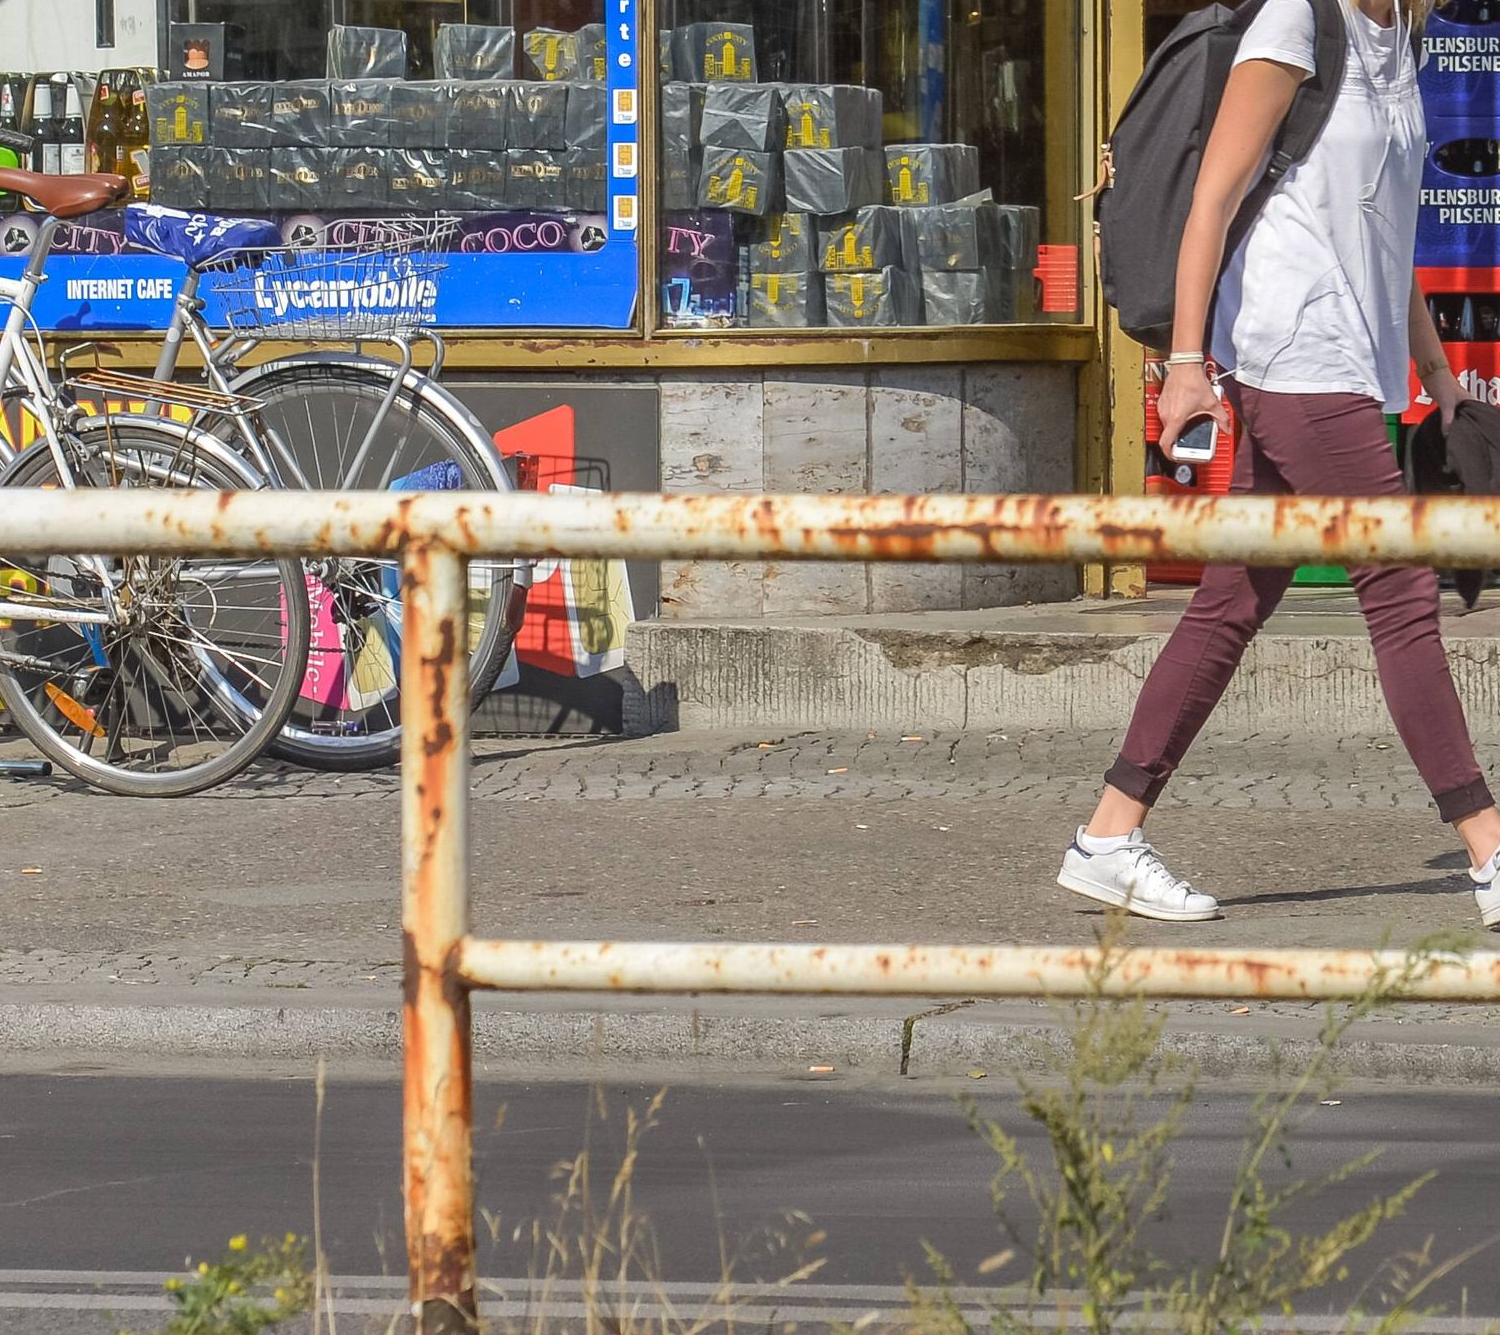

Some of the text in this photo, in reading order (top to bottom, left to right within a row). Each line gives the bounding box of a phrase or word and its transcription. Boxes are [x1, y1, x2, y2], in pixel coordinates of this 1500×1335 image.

[460, 218, 568, 254] COCO
[66, 277, 174, 301] INTERNET CAFE
